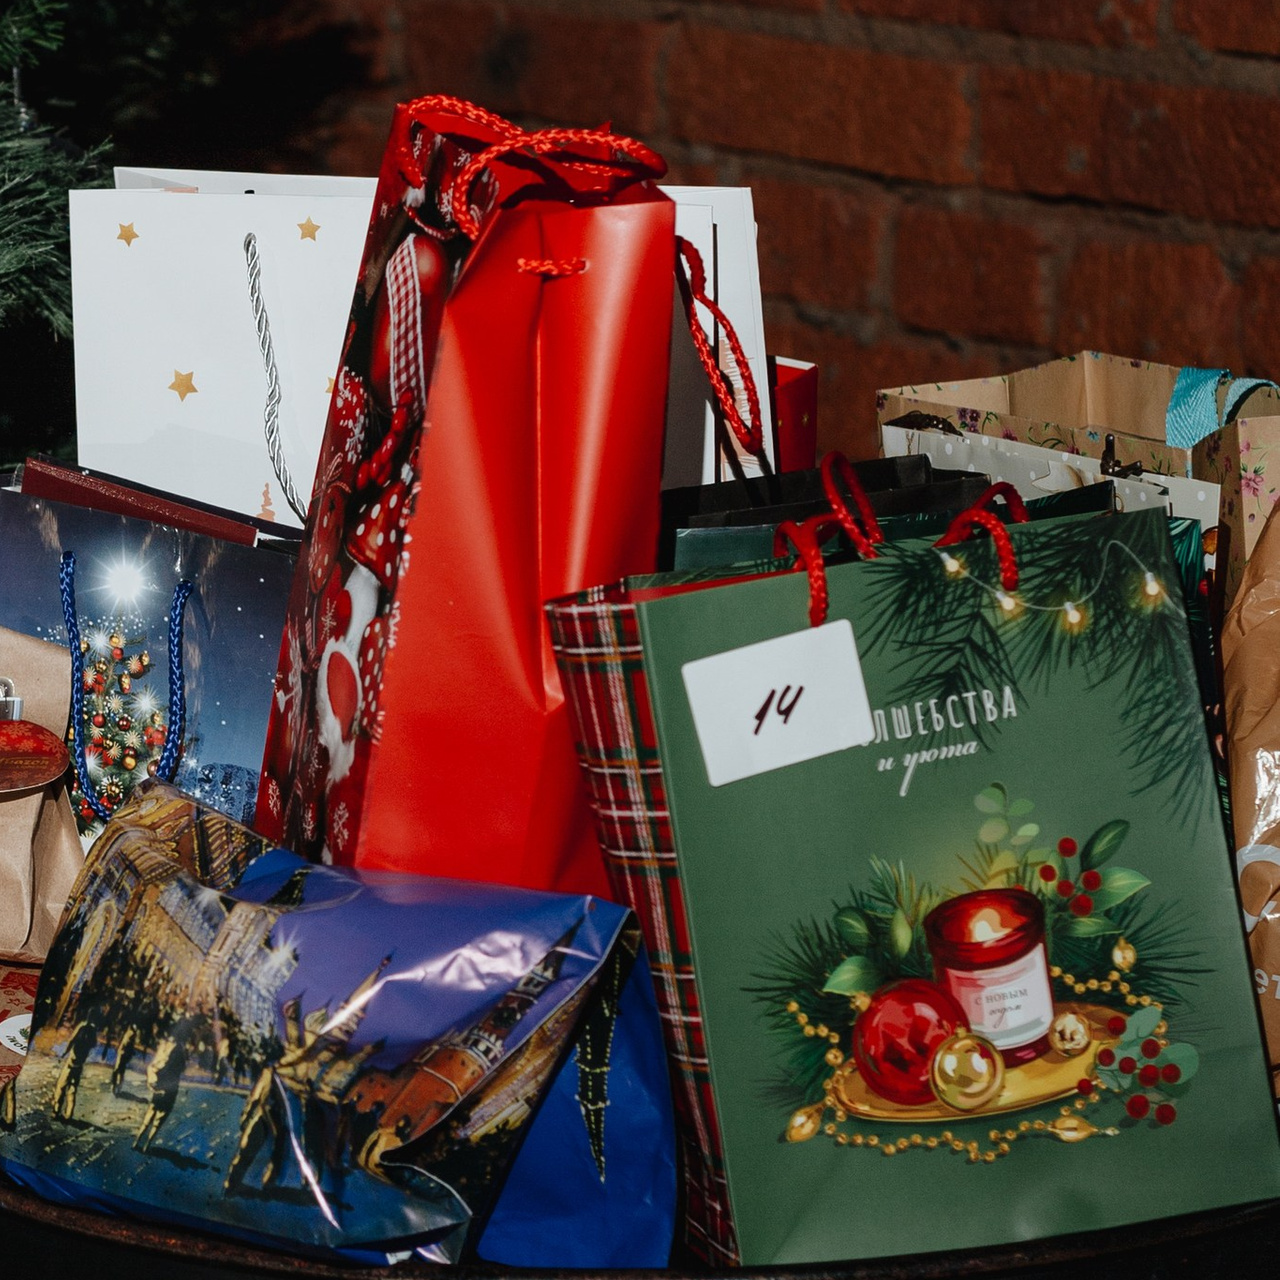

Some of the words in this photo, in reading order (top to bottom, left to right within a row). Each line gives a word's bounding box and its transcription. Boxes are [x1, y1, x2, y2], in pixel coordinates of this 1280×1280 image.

[754, 685, 804, 736] 14
[860, 685, 1018, 746] ЛШЕБСТВА
[877, 757, 896, 772] и
[899, 741, 980, 797] уюта
